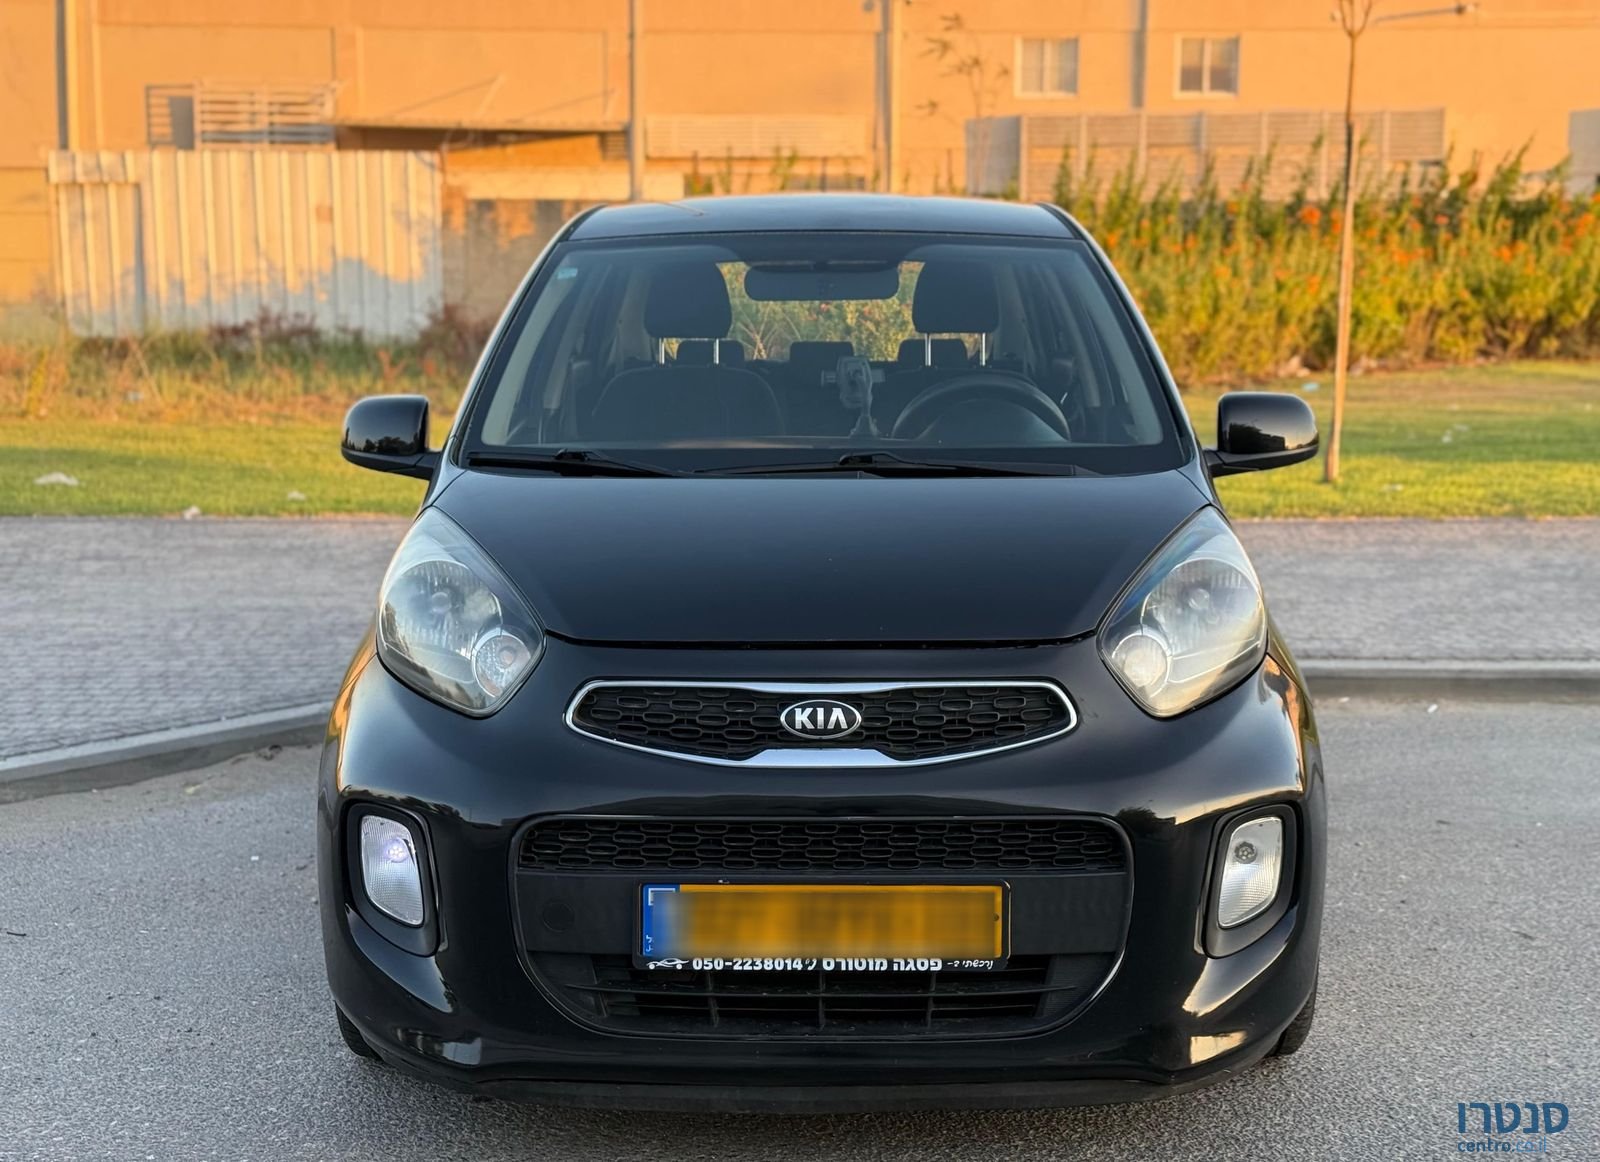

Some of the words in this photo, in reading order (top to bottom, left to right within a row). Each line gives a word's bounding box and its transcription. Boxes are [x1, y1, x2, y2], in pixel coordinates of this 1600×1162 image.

[795, 708, 847, 729] KIA
[692, 957, 803, 971] 050-2238014
[822, 957, 888, 971] מוטורס
[892, 957, 943, 971] פסגה
